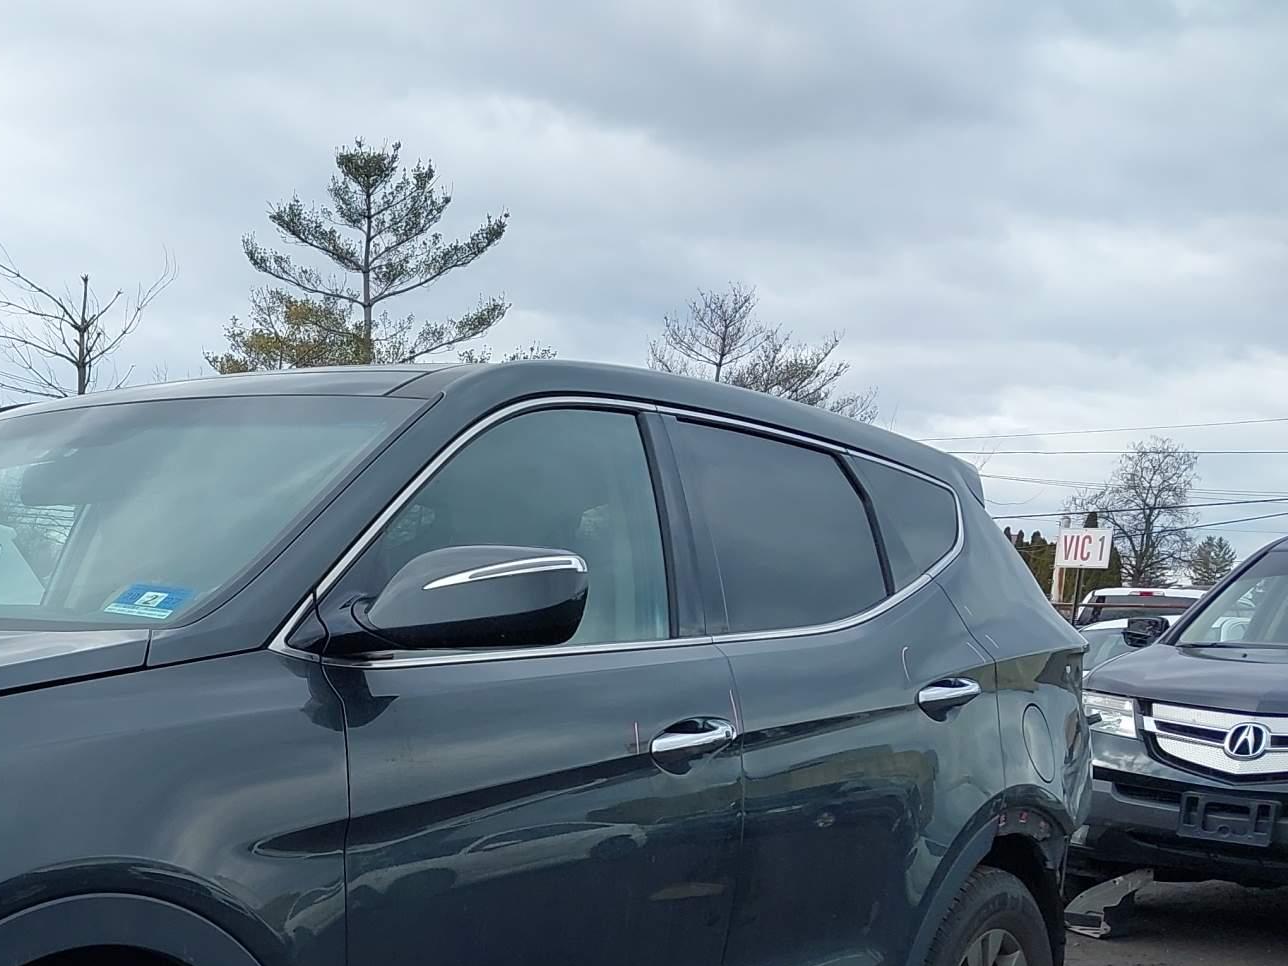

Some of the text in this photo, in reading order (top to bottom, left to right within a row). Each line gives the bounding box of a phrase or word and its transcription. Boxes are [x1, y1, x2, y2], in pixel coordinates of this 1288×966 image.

[1064, 534, 1106, 562] VIC 1
[142, 594, 160, 606] 2
